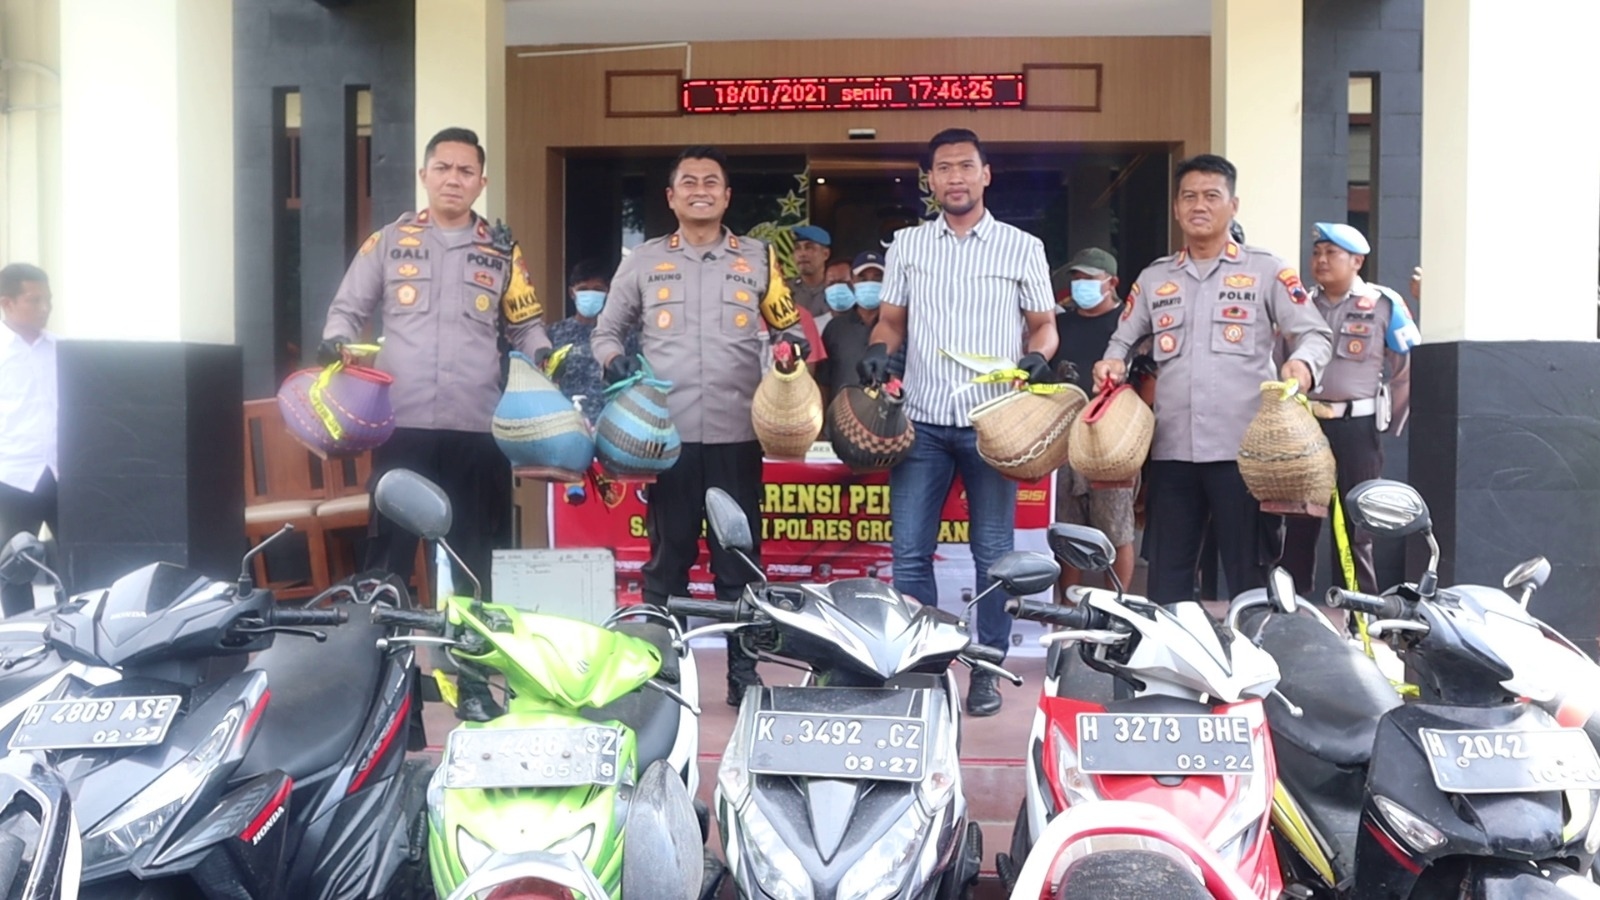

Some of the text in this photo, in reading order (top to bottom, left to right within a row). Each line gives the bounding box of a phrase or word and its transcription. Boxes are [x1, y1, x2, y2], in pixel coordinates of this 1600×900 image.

[715, 80, 994, 105] 18/01/2021 senin 17:46:25
[390, 248, 429, 260] GALI
[467, 252, 503, 271] POLRI
[648, 273, 682, 283] ANUNG
[725, 273, 757, 287] POLRI
[1219, 291, 1256, 301] POLRI
[774, 518, 852, 541] POLRES
[24, 699, 171, 725] H 4809 ASE
[585, 727, 616, 756] SZ
[757, 717, 922, 749] K 3492 GZ
[1082, 716, 1249, 743] H 3273 BHE
[1425, 732, 1530, 759] H 2042
[252, 805, 285, 846] HONDA
